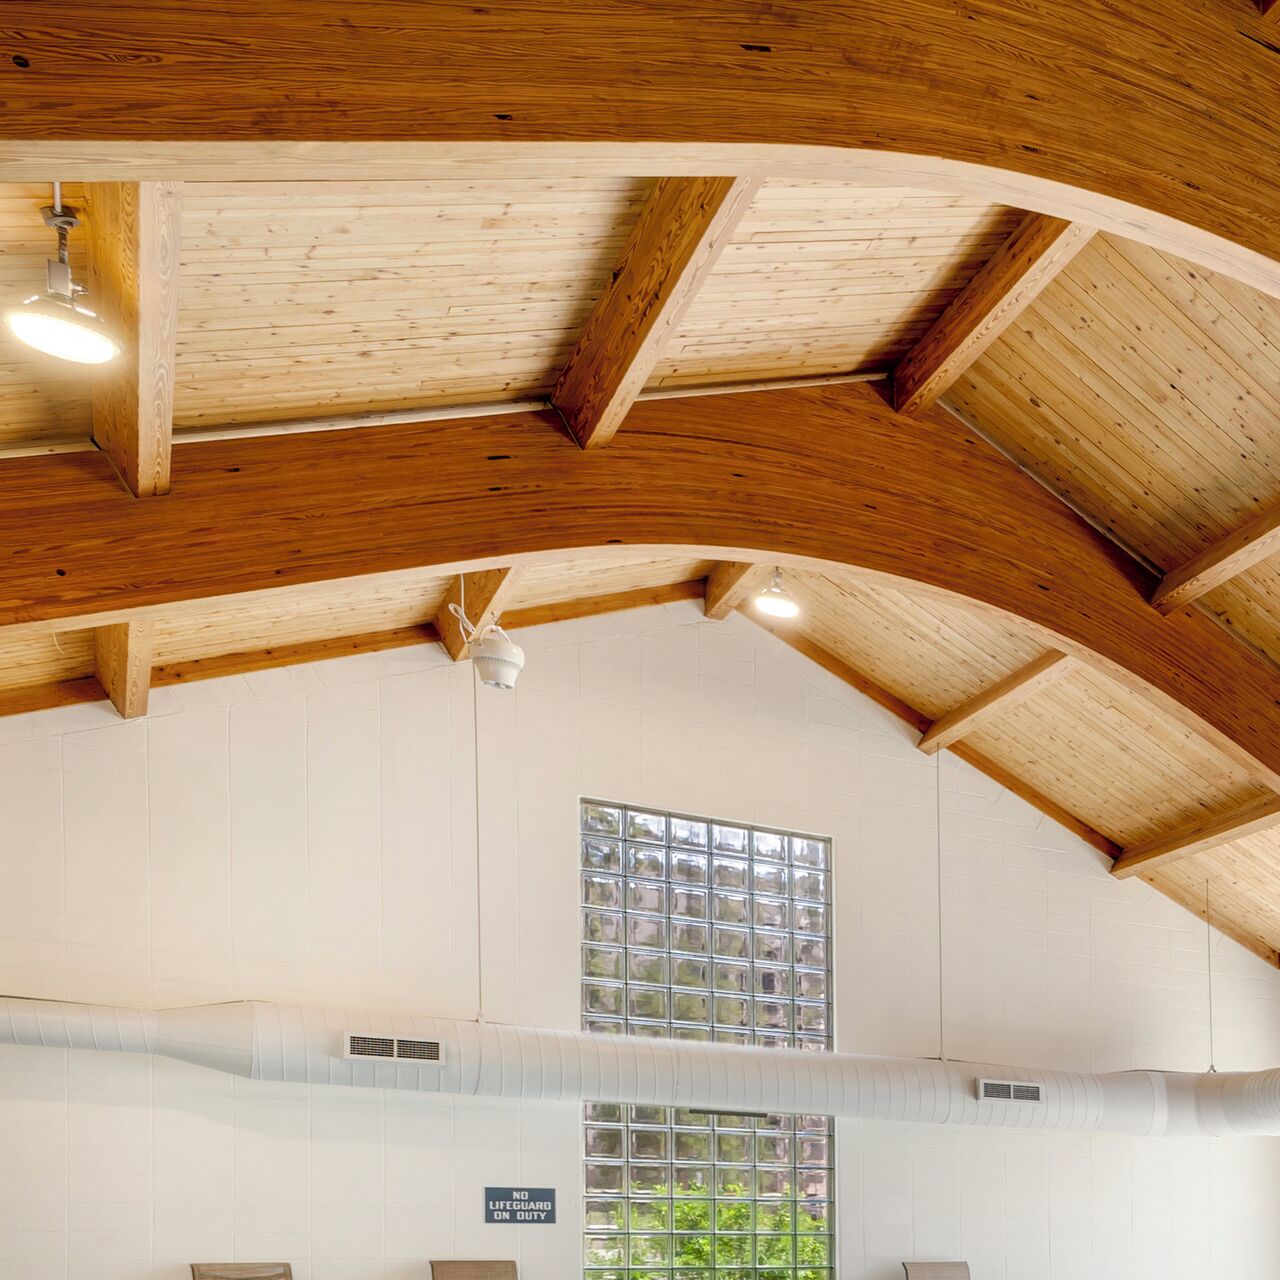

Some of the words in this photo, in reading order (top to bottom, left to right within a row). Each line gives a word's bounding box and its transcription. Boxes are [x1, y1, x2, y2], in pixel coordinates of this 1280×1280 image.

[513, 1191, 528, 1200] NO
[490, 1201, 552, 1210] LIFEGUARD
[494, 1212, 510, 1220] ON
[517, 1212, 547, 1220] DUTY
